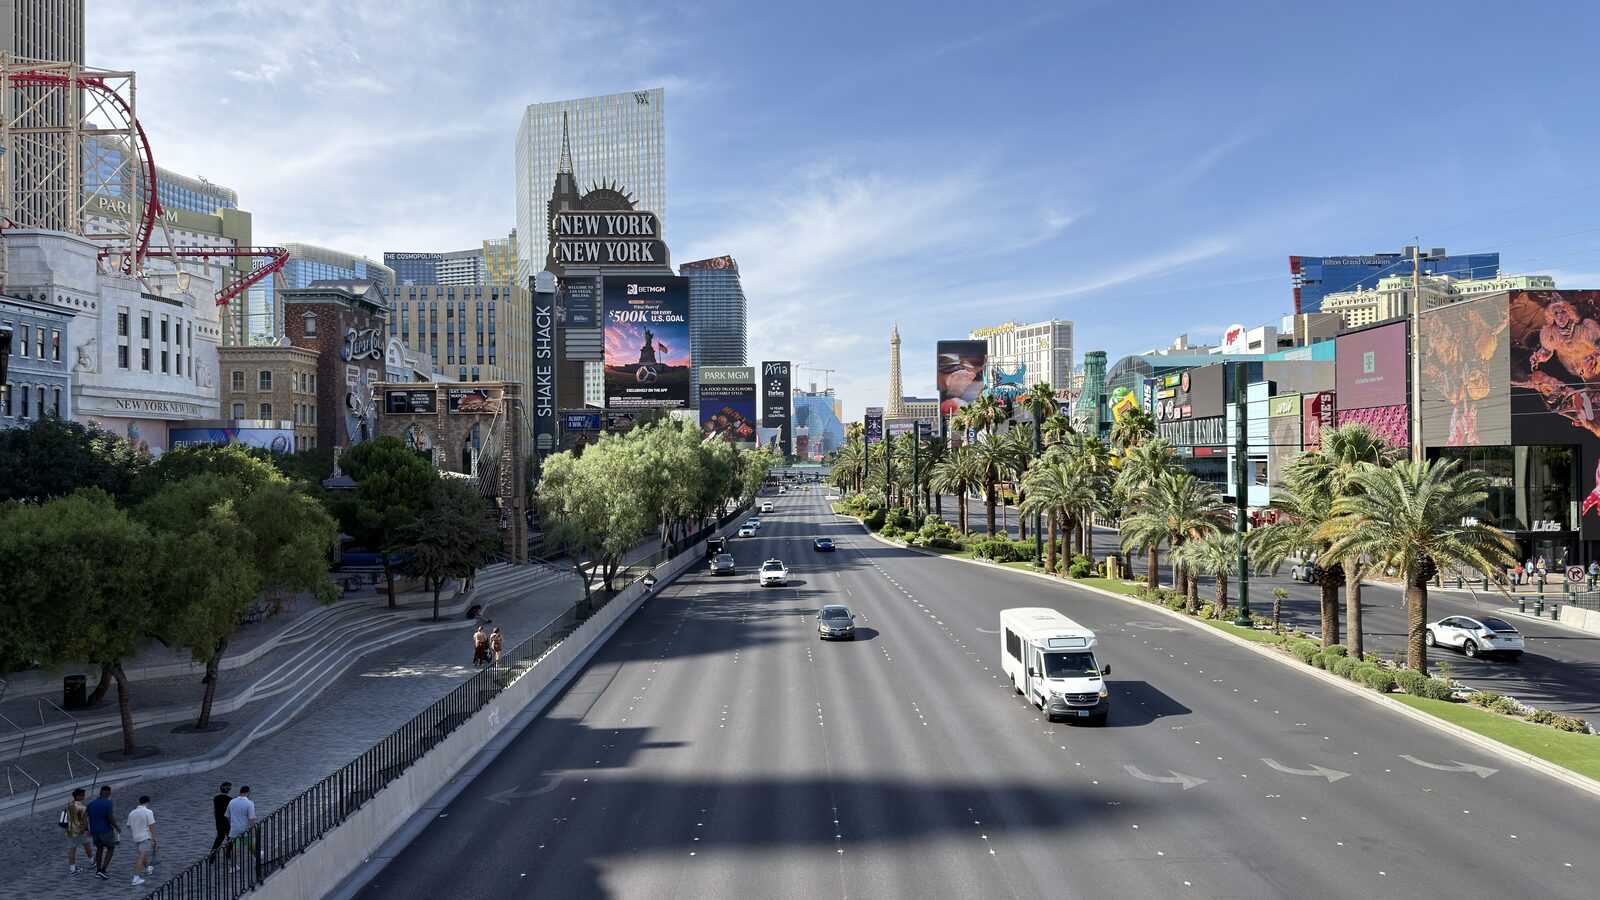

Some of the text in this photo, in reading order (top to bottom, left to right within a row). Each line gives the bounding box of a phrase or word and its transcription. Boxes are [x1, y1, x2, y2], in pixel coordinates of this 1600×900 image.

[560, 215, 654, 235] NEW YORK
[560, 241, 654, 262] NEW YORK
[609, 310, 649, 322] $500K
[536, 305, 552, 417] SHAKE SHACK
[765, 363, 788, 376] Aria
[116, 400, 199, 415] NEW YORK NEW YORK
[1321, 394, 1331, 427] ANE'S
[1194, 418, 1223, 444] RESORTS
[1533, 521, 1560, 531] Lids
